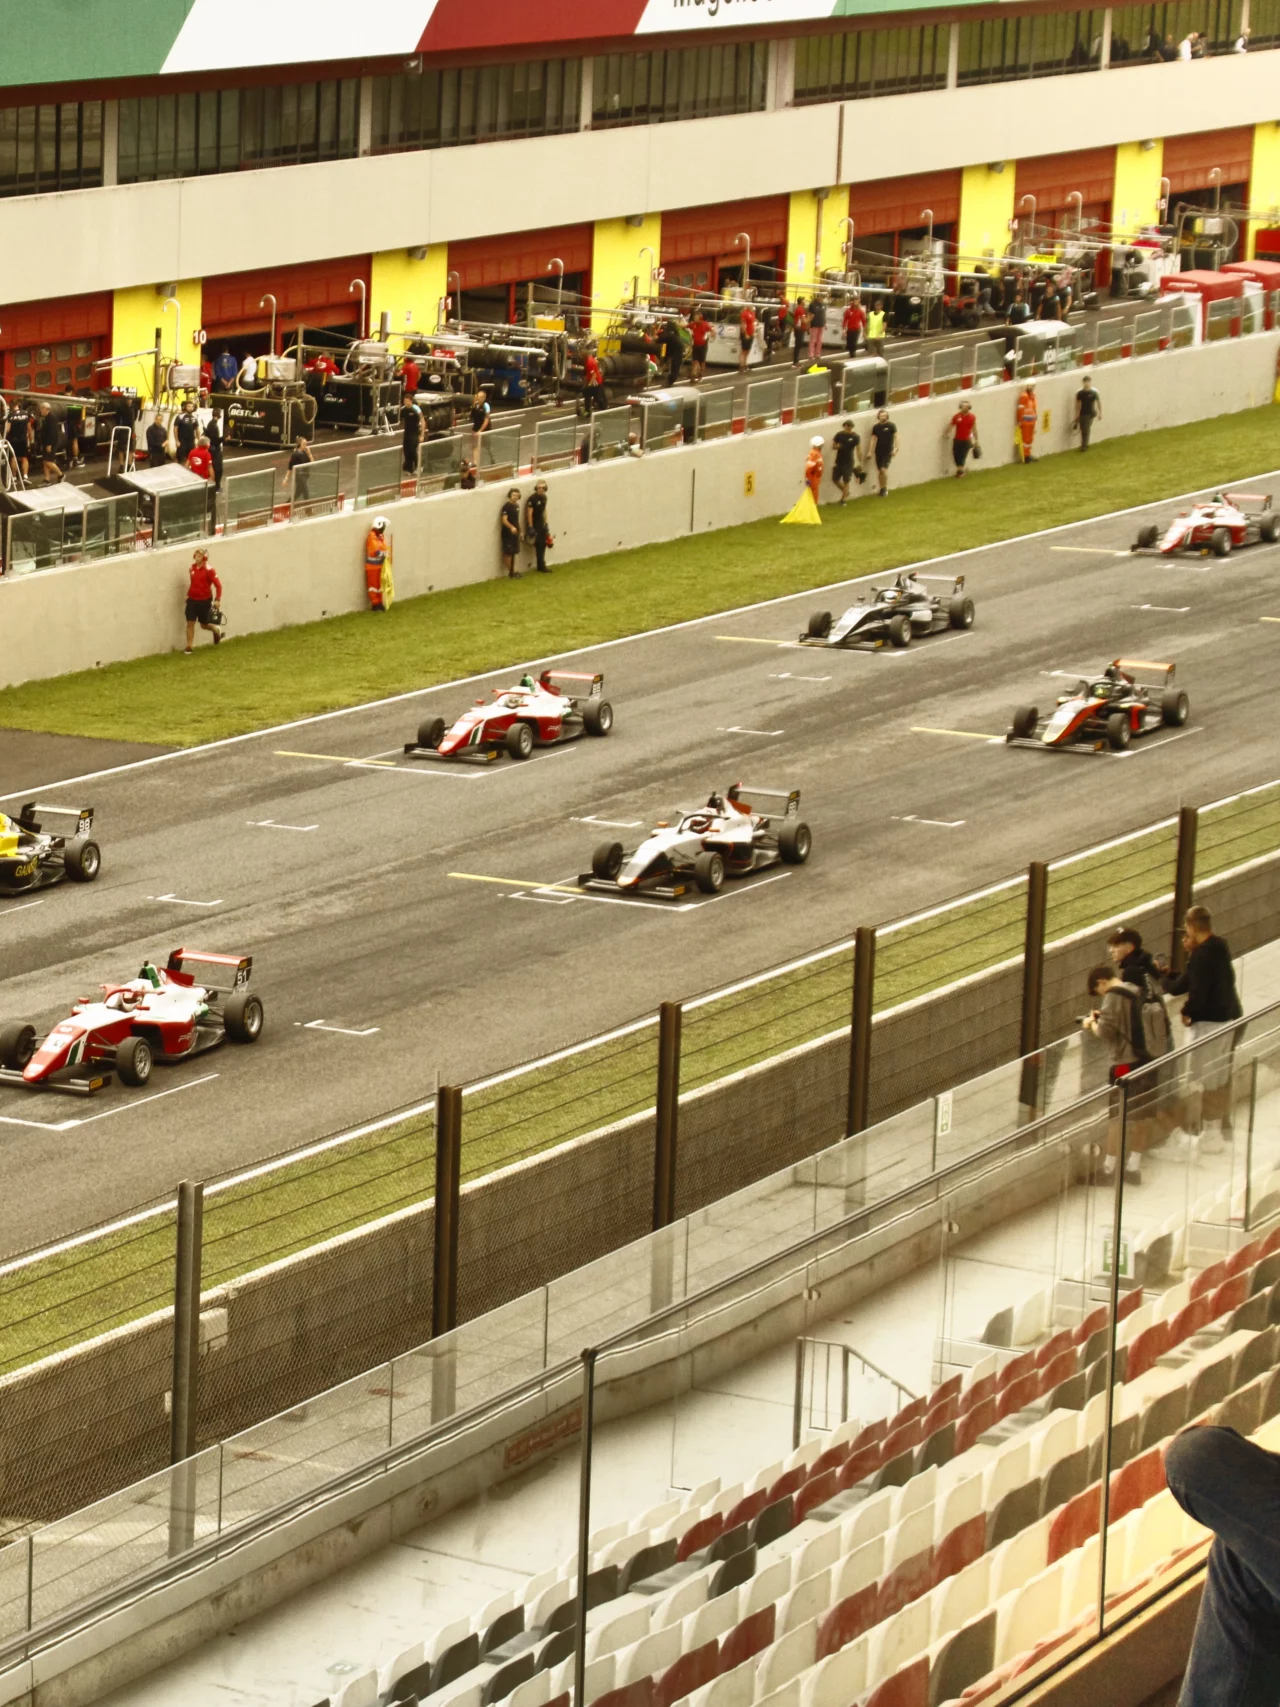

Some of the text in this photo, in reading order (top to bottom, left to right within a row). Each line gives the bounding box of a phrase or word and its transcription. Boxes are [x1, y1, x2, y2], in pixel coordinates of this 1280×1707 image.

[653, 268, 665, 280] 12
[440, 297, 452, 310] 11
[193, 330, 207, 344] 10
[747, 475, 753, 492] 5
[79, 818, 90, 832] 98
[237, 970, 247, 985] 51
